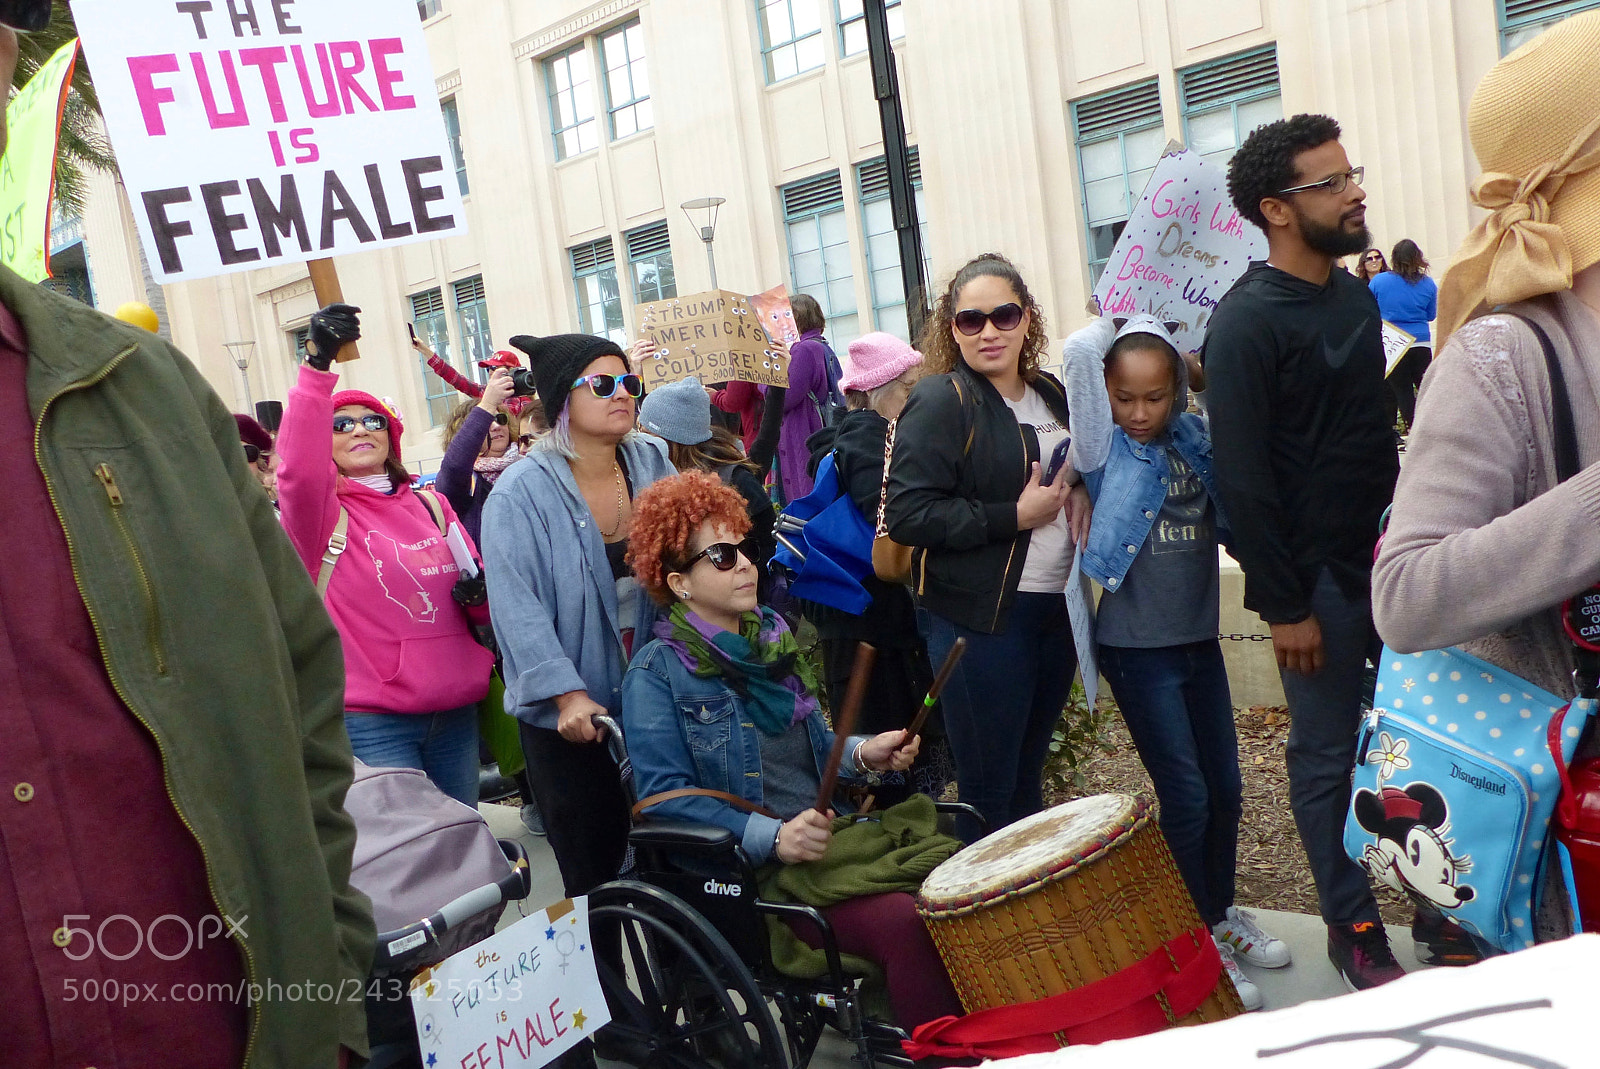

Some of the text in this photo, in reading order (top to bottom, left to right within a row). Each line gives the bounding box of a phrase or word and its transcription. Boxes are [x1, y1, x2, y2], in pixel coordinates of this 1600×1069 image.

[175, 0, 303, 40] THE
[126, 37, 417, 137] FUTURE
[267, 127, 320, 167] IS
[140, 155, 457, 275] FEMALE
[1151, 179, 1244, 240] Girls With
[1156, 221, 1222, 269] Dreams
[1116, 245, 1174, 290] Become
[659, 298, 726, 323] TRUMP
[651, 321, 762, 347] AMERICA'S
[420, 566, 440, 576] SAN
[1449, 762, 1507, 797] Disneyland
[704, 879, 742, 897] drive
[474, 950, 501, 969] the
[452, 946, 542, 1018] FUTURE
[460, 997, 568, 1069] FEMALE
[496, 1009, 508, 1024] is
